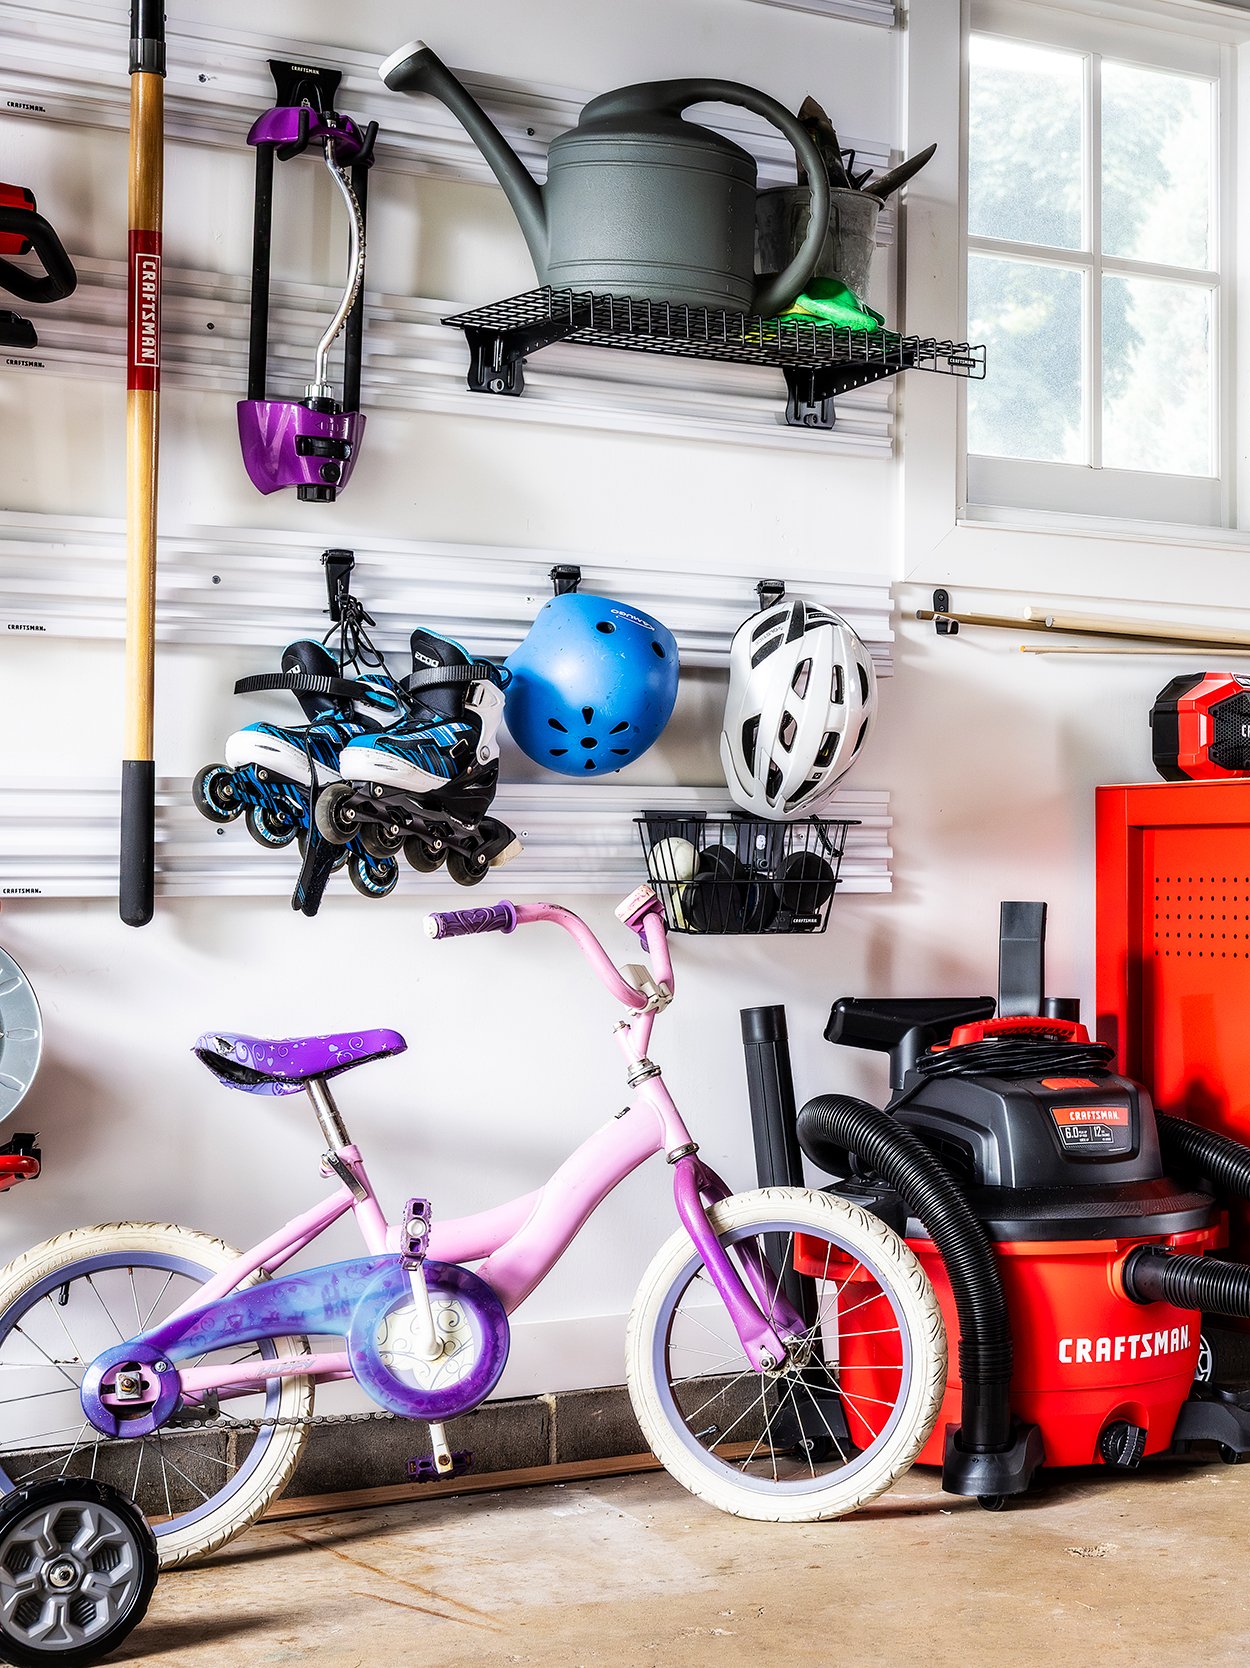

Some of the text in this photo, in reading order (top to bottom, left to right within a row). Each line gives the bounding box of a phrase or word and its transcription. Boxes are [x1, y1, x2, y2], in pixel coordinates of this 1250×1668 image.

[142, 260, 156, 359] CRAFTSMAN
[1069, 1111, 1120, 1121] CRAFTSMAN
[1064, 1126, 1079, 1139] 6.0
[1093, 1125, 1102, 1137] 12
[1058, 1324, 1191, 1364] CRAFTSMAN
